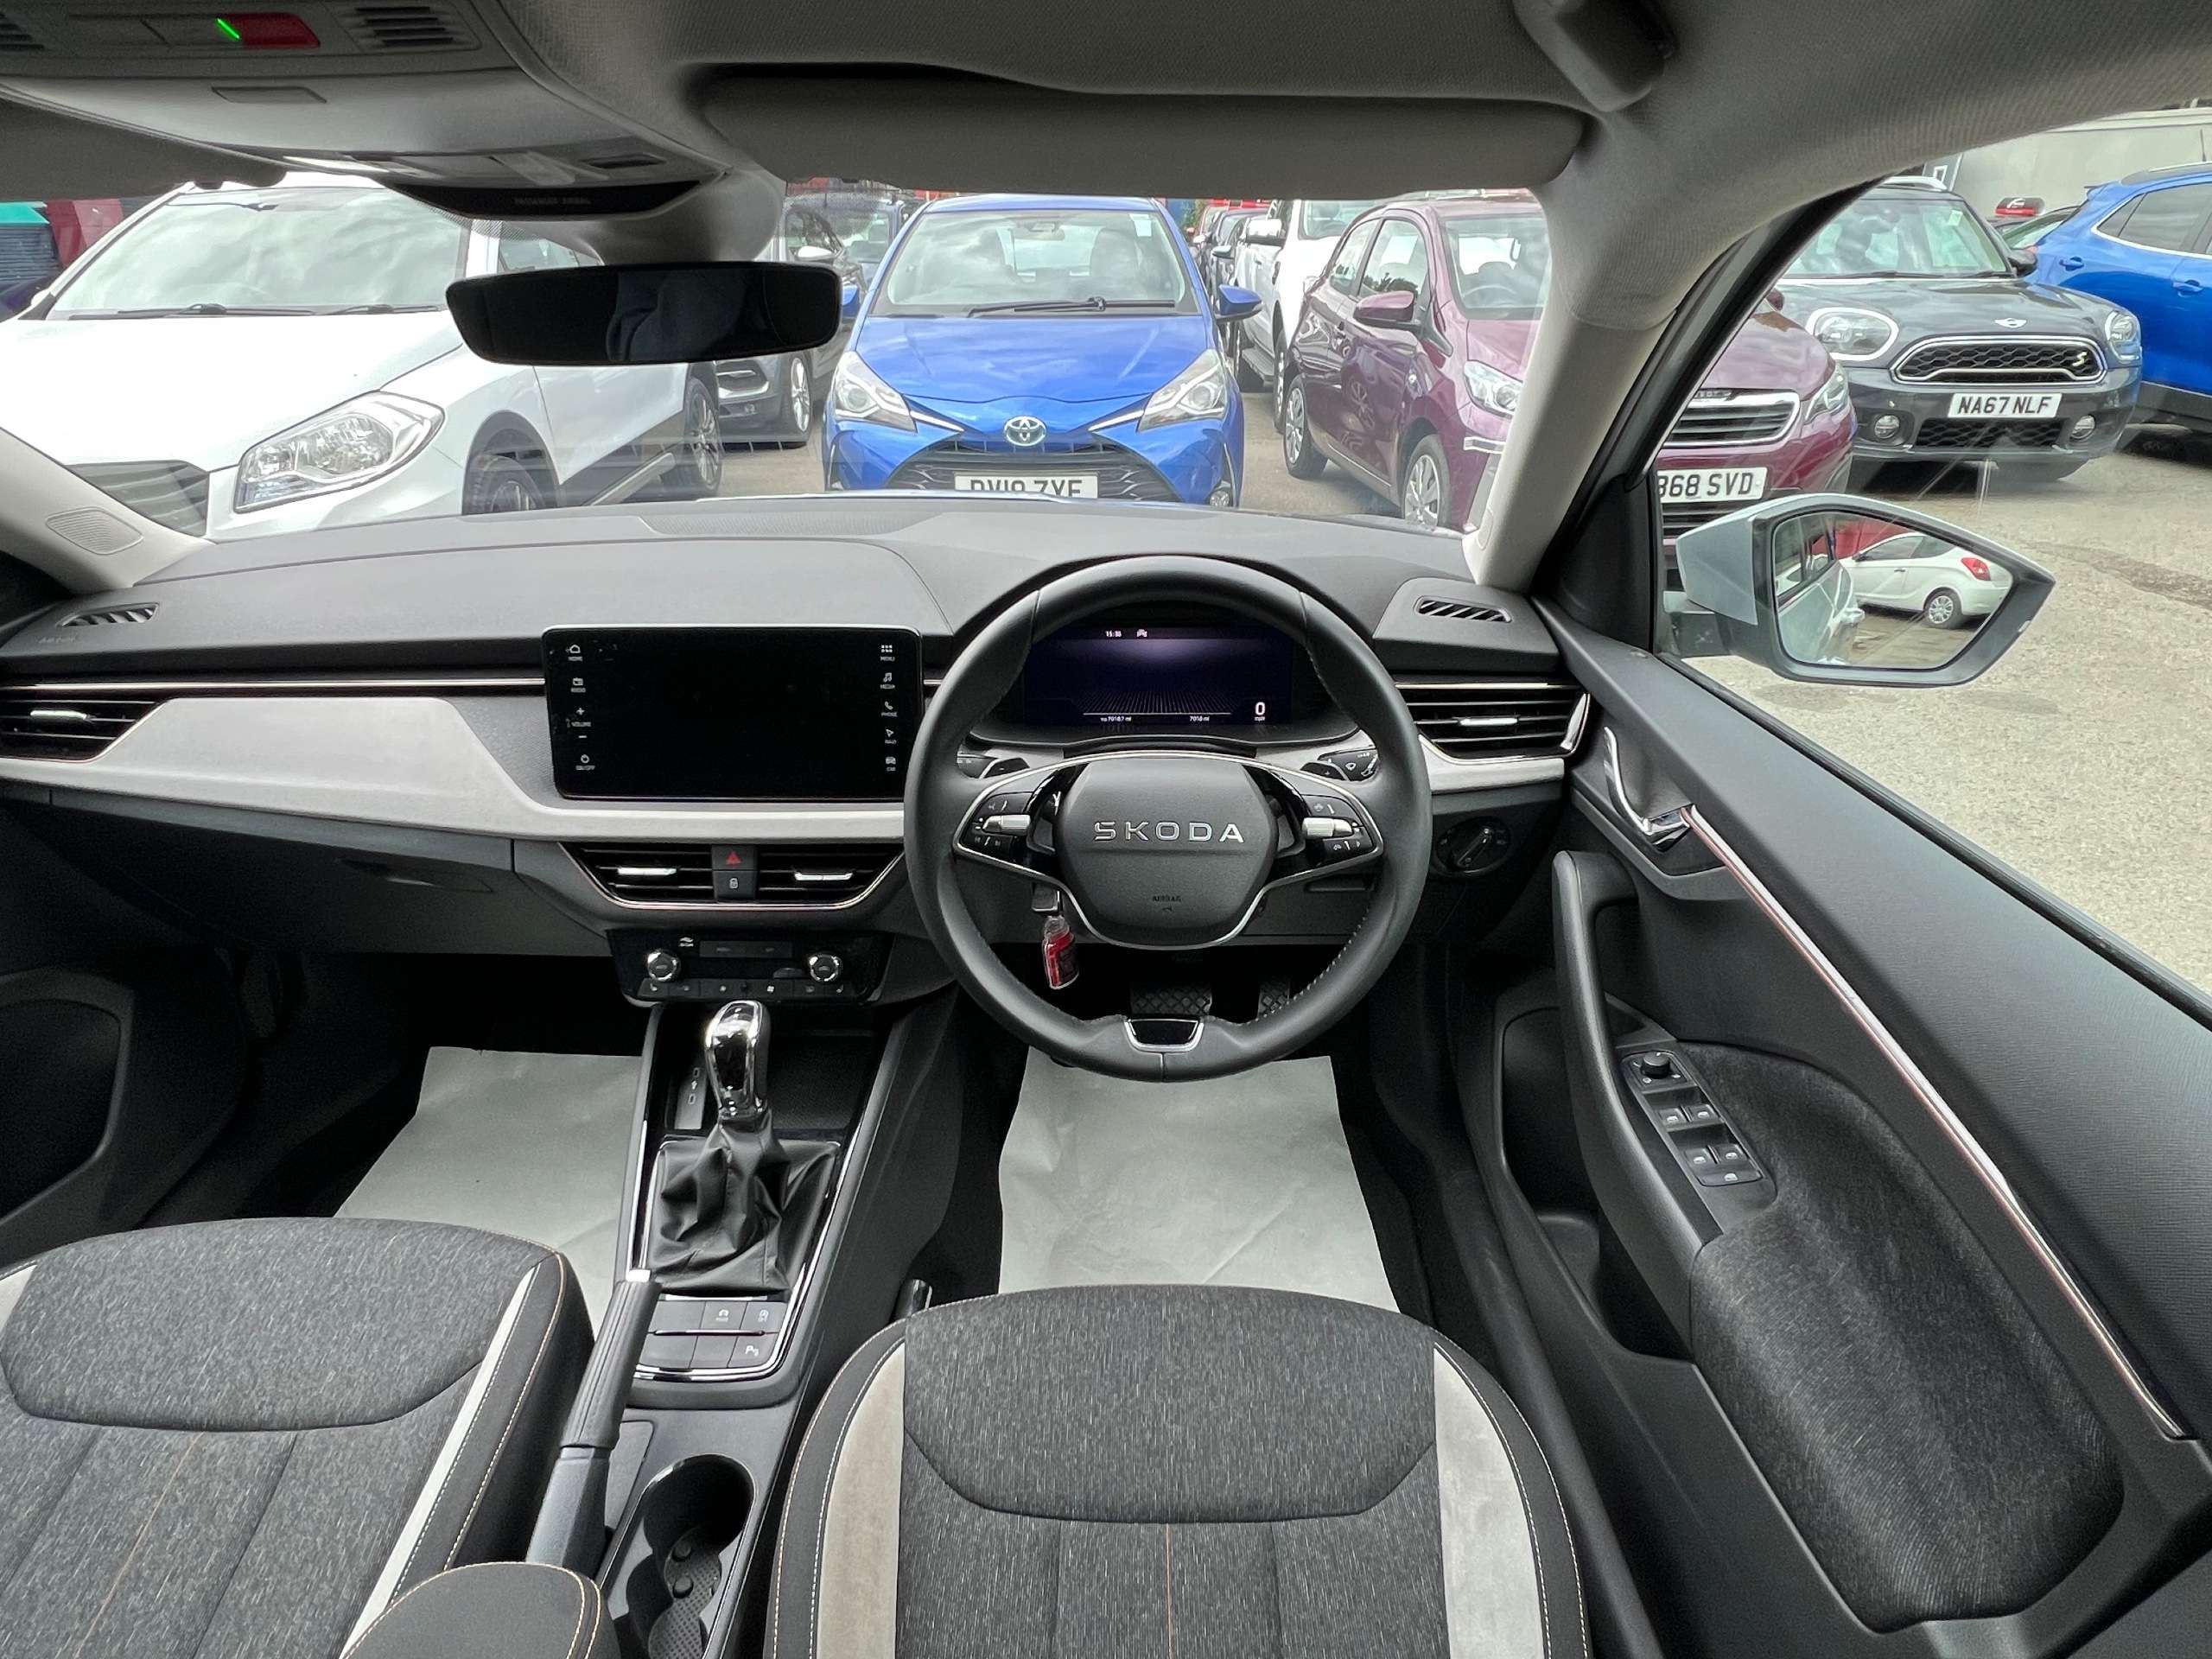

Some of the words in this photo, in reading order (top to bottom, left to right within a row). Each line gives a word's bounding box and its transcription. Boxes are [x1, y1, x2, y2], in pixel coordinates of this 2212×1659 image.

[1957, 396, 2011, 414] NA67
[2012, 396, 2053, 414] NLF
[1707, 472, 1753, 496] SVD
[1255, 702, 1266, 715] 0
[1093, 821, 1246, 844] SKODA
